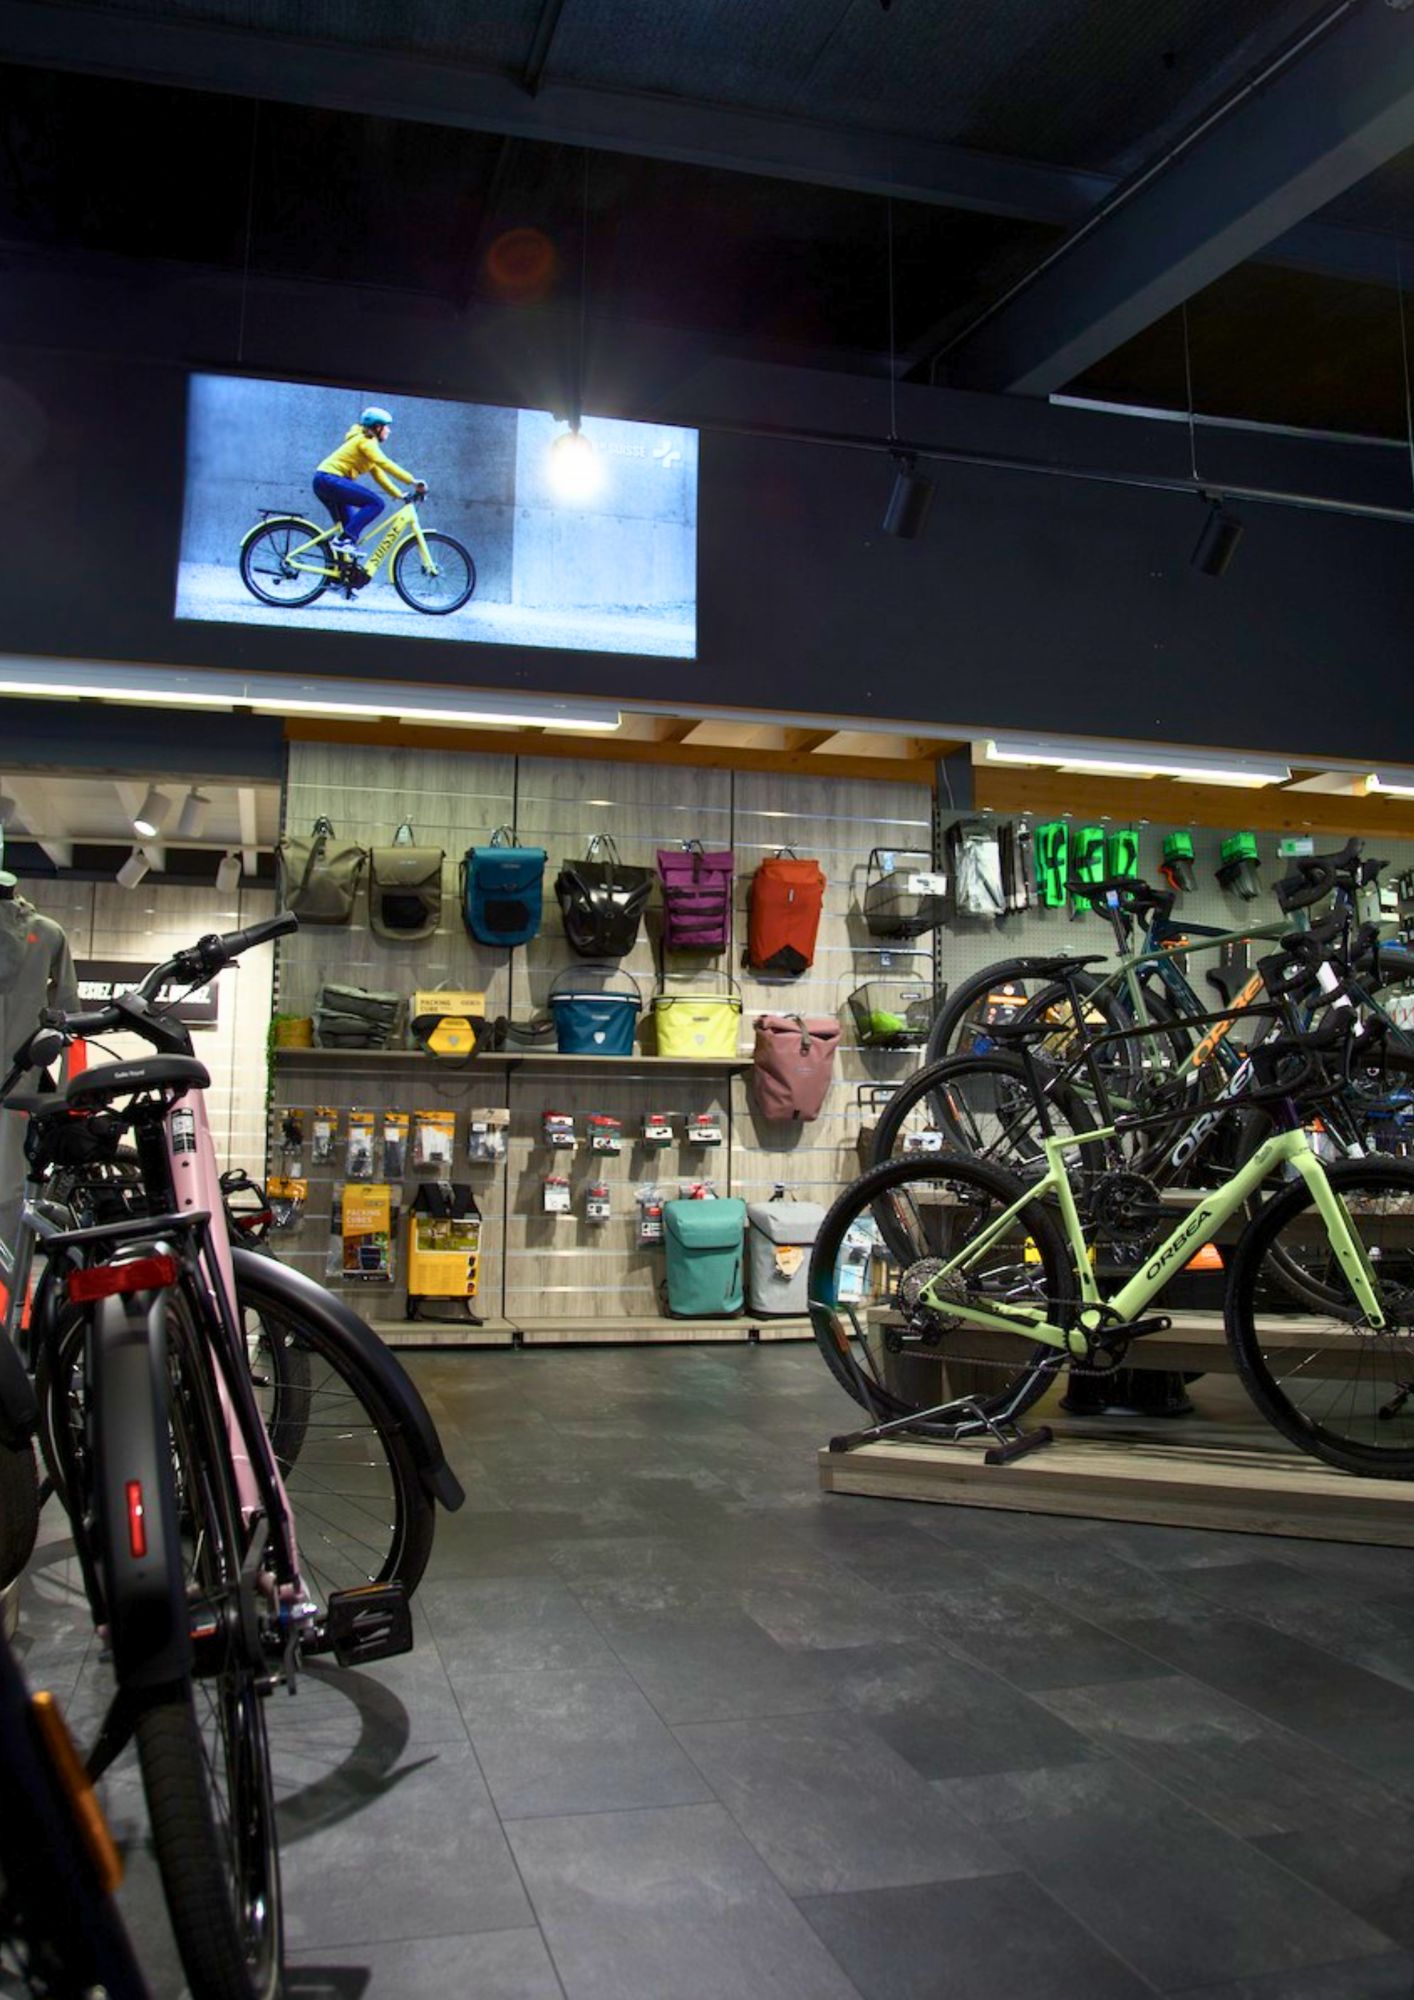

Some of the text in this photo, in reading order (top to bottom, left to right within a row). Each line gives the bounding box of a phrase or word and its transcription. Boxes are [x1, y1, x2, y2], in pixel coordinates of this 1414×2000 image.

[370, 525, 400, 567] SUISSE
[346, 1208, 382, 1217] PACKING
[346, 1216, 373, 1224] CUBES
[1146, 1210, 1212, 1281] ORBEA
